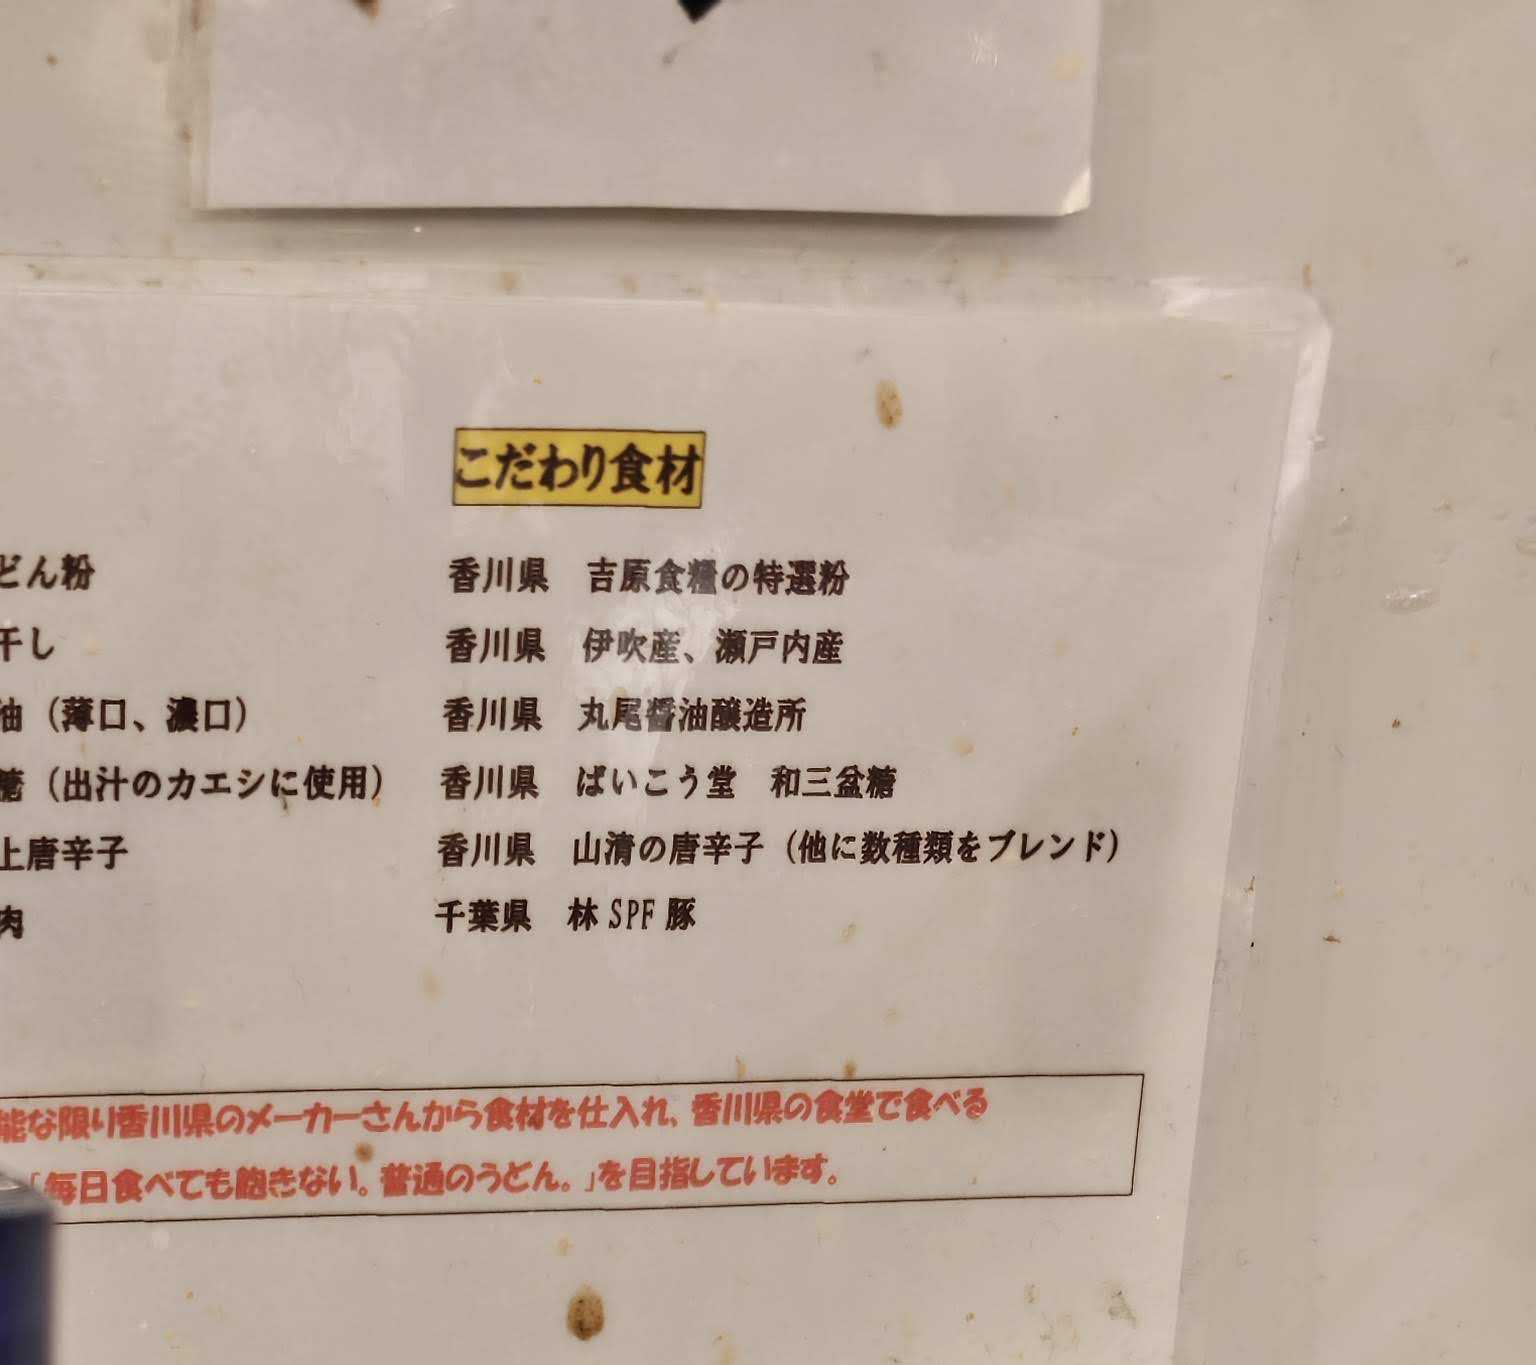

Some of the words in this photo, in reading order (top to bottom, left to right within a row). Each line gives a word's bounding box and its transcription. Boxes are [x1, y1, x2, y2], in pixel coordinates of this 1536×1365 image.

[458, 442, 701, 496] こだわり食材
[448, 556, 550, 594] 香川県
[586, 555, 851, 597] 吉原食糧の特選粉
[445, 626, 546, 664] 香川県
[582, 626, 845, 665] 伊吹産、瀬戸内産
[442, 695, 543, 733] 香川県
[577, 695, 807, 733] 丸尾醤油醸造所
[440, 764, 540, 801] 香川県
[769, 763, 898, 800] 和三盆糖
[437, 831, 536, 869] 香川県
[434, 898, 533, 934] 千葉県
